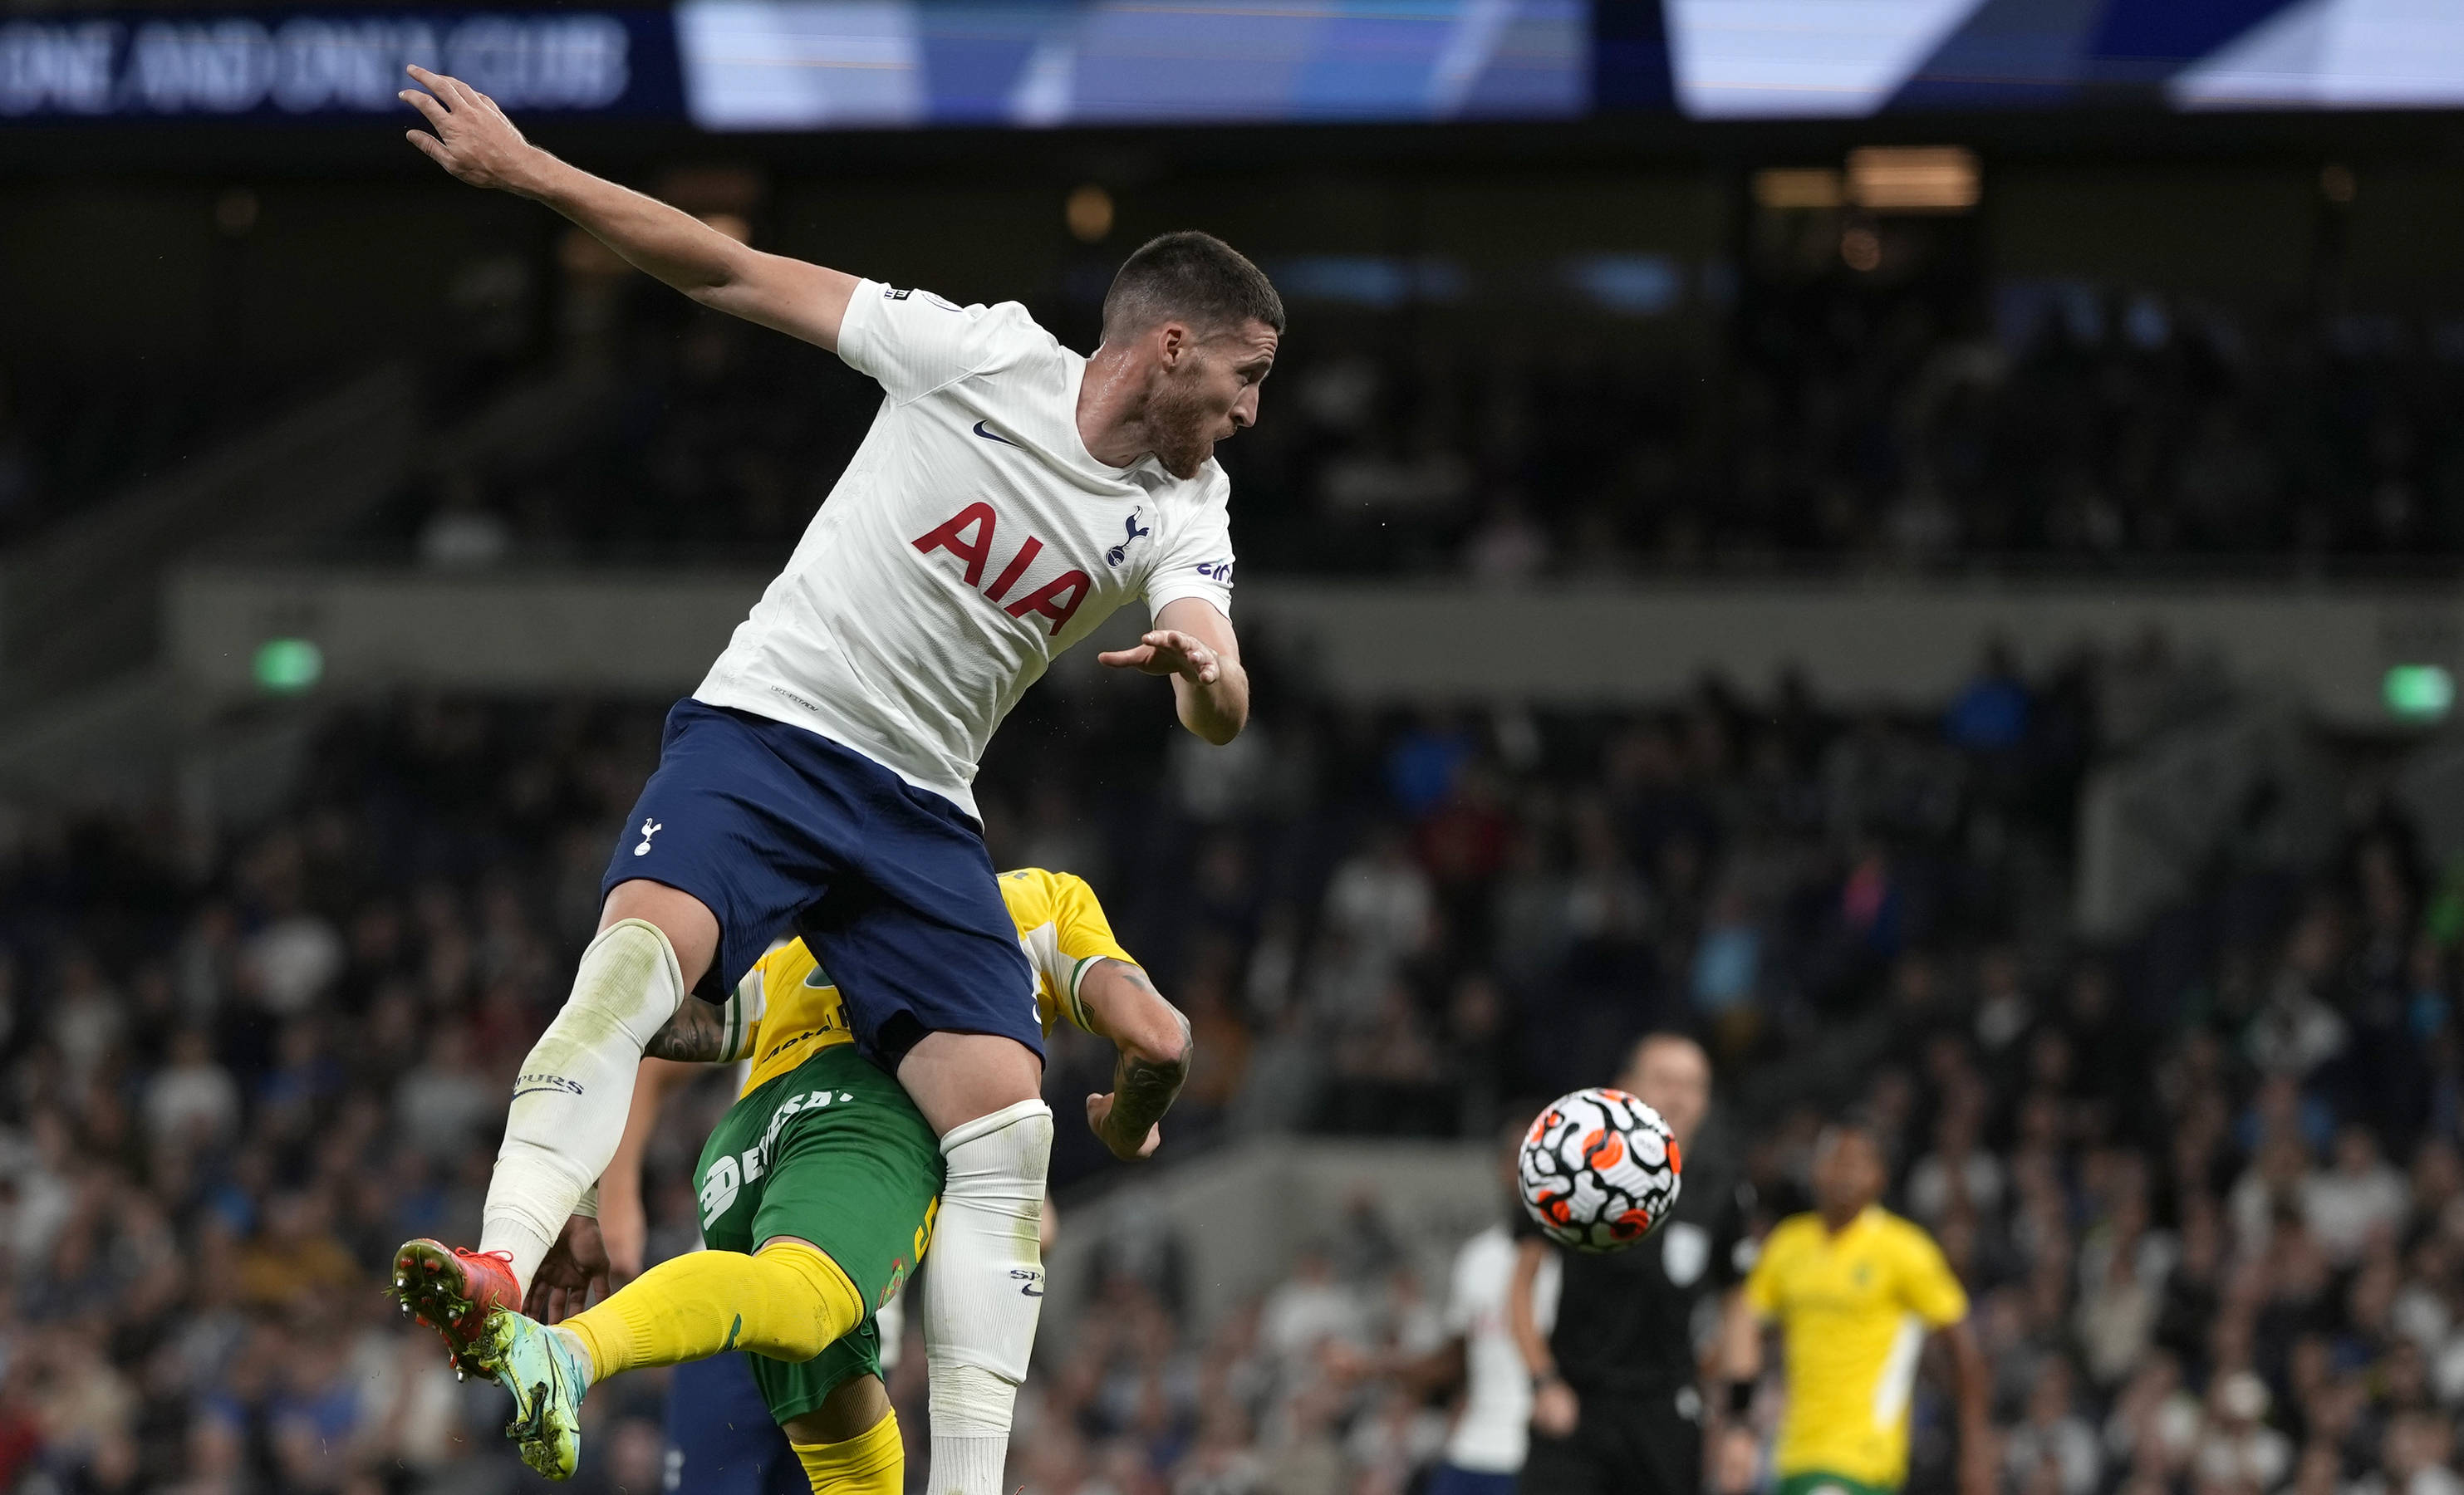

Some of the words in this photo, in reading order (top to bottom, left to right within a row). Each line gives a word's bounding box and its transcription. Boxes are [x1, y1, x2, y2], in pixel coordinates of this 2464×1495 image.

[129, 18, 276, 115] AND
[444, 15, 630, 110] CLUB
[911, 502, 1091, 636] AIA
[512, 1074, 585, 1096] PURS
